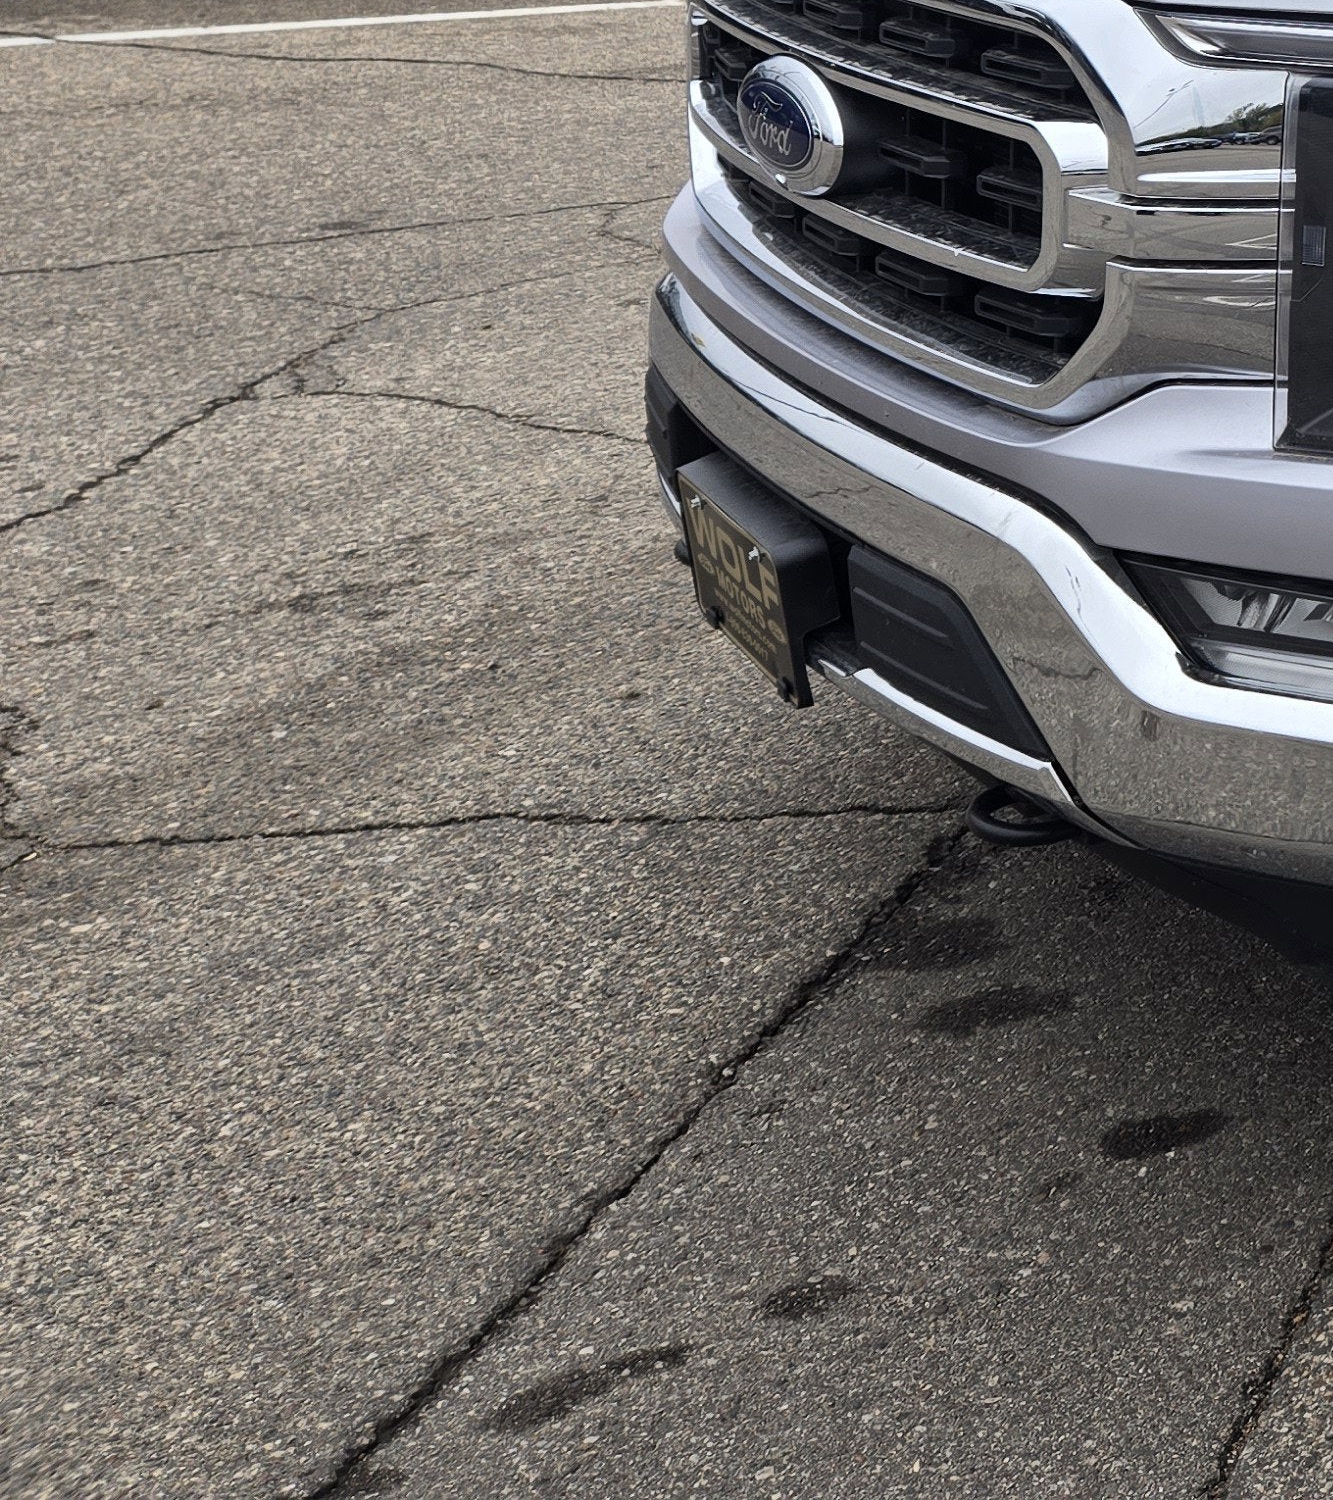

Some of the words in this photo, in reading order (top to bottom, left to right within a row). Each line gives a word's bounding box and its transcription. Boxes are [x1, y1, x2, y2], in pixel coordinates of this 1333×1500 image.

[748, 91, 795, 156] Ford
[686, 497, 780, 610] WOLF
[715, 566, 766, 630] MOTORS
